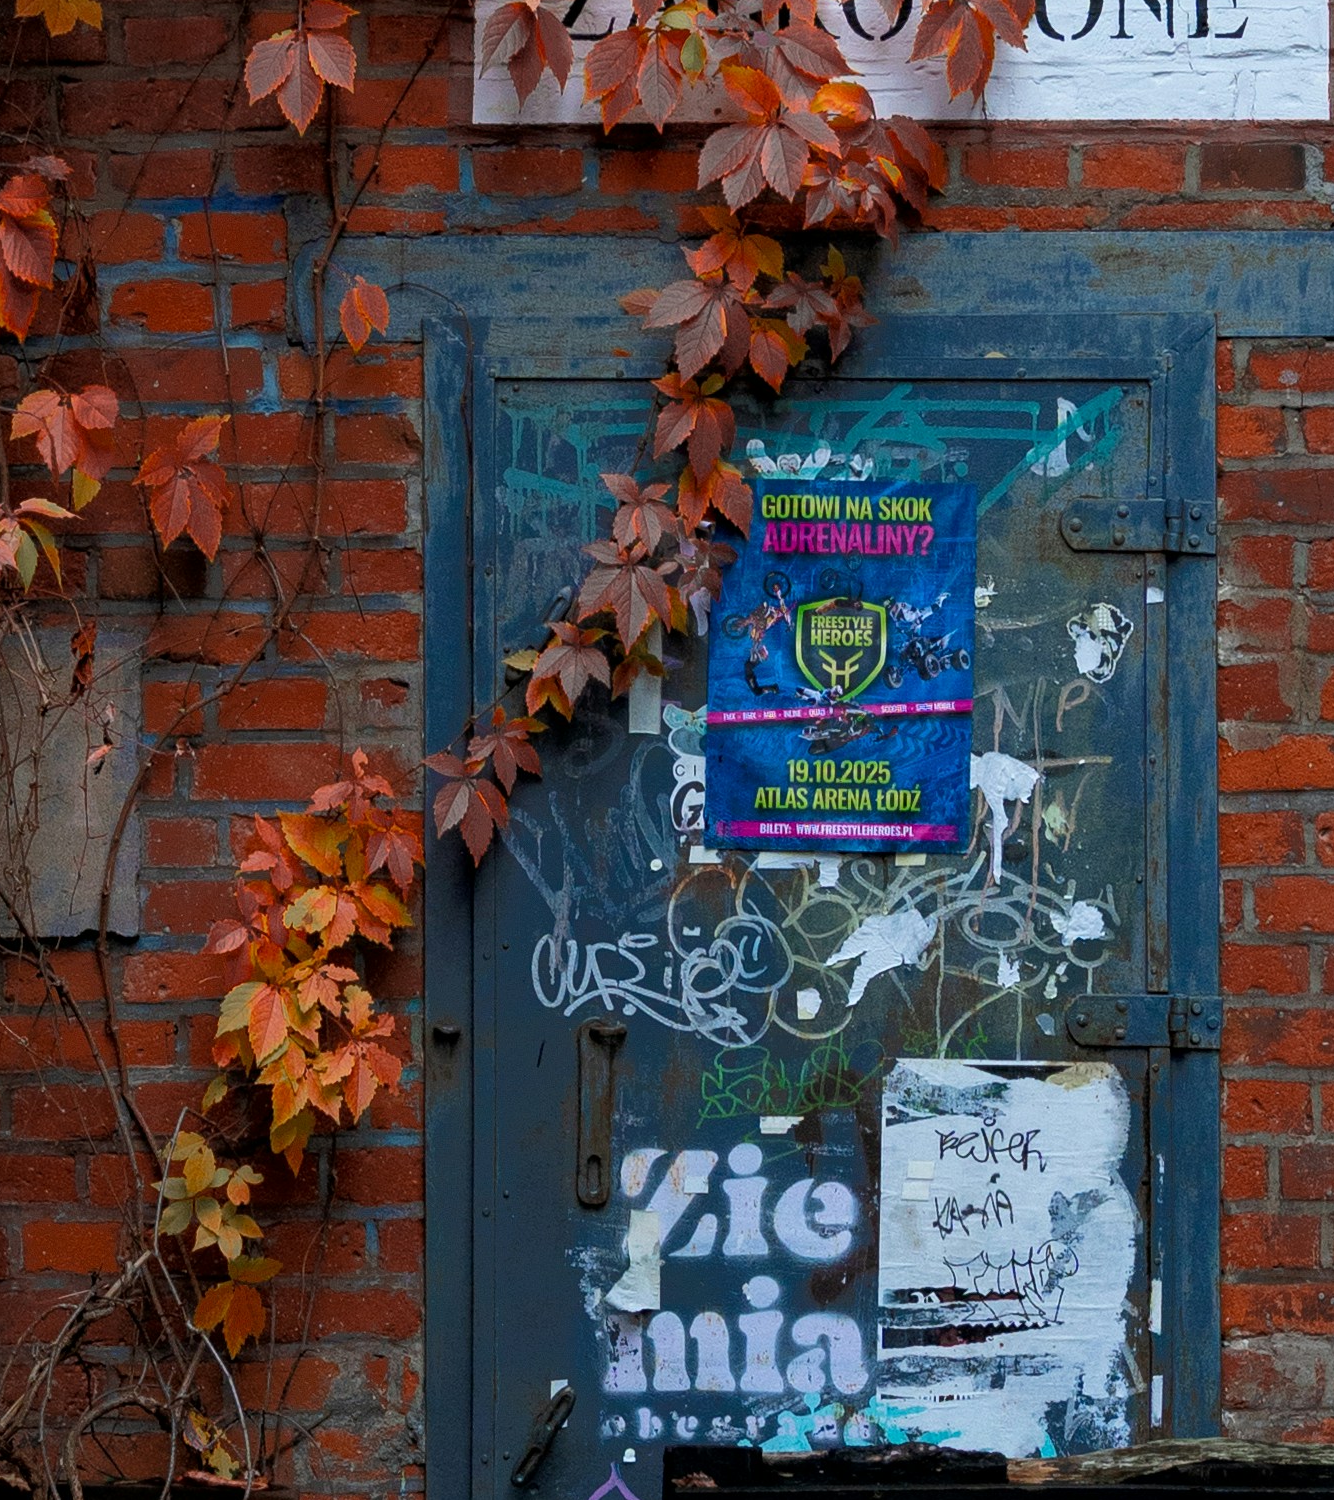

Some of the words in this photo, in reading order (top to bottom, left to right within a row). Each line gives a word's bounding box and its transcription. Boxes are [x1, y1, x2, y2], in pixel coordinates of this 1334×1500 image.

[761, 494, 840, 519] GOTOWI
[846, 496, 873, 520] NA
[878, 496, 933, 522] SKOK
[762, 521, 935, 556] ADRENALINY?
[810, 615, 874, 629] FREESTYLE
[810, 629, 873, 647] HEROES
[786, 758, 891, 785] 19.10.2025
[754, 786, 808, 809] ATLAS
[813, 787, 872, 811] ARENA
[875, 783, 922, 812] ŁÓDŹ
[759, 822, 792, 835] BILETY:
[796, 823, 915, 838] WWW.FREESTYLEHEROES.PL
